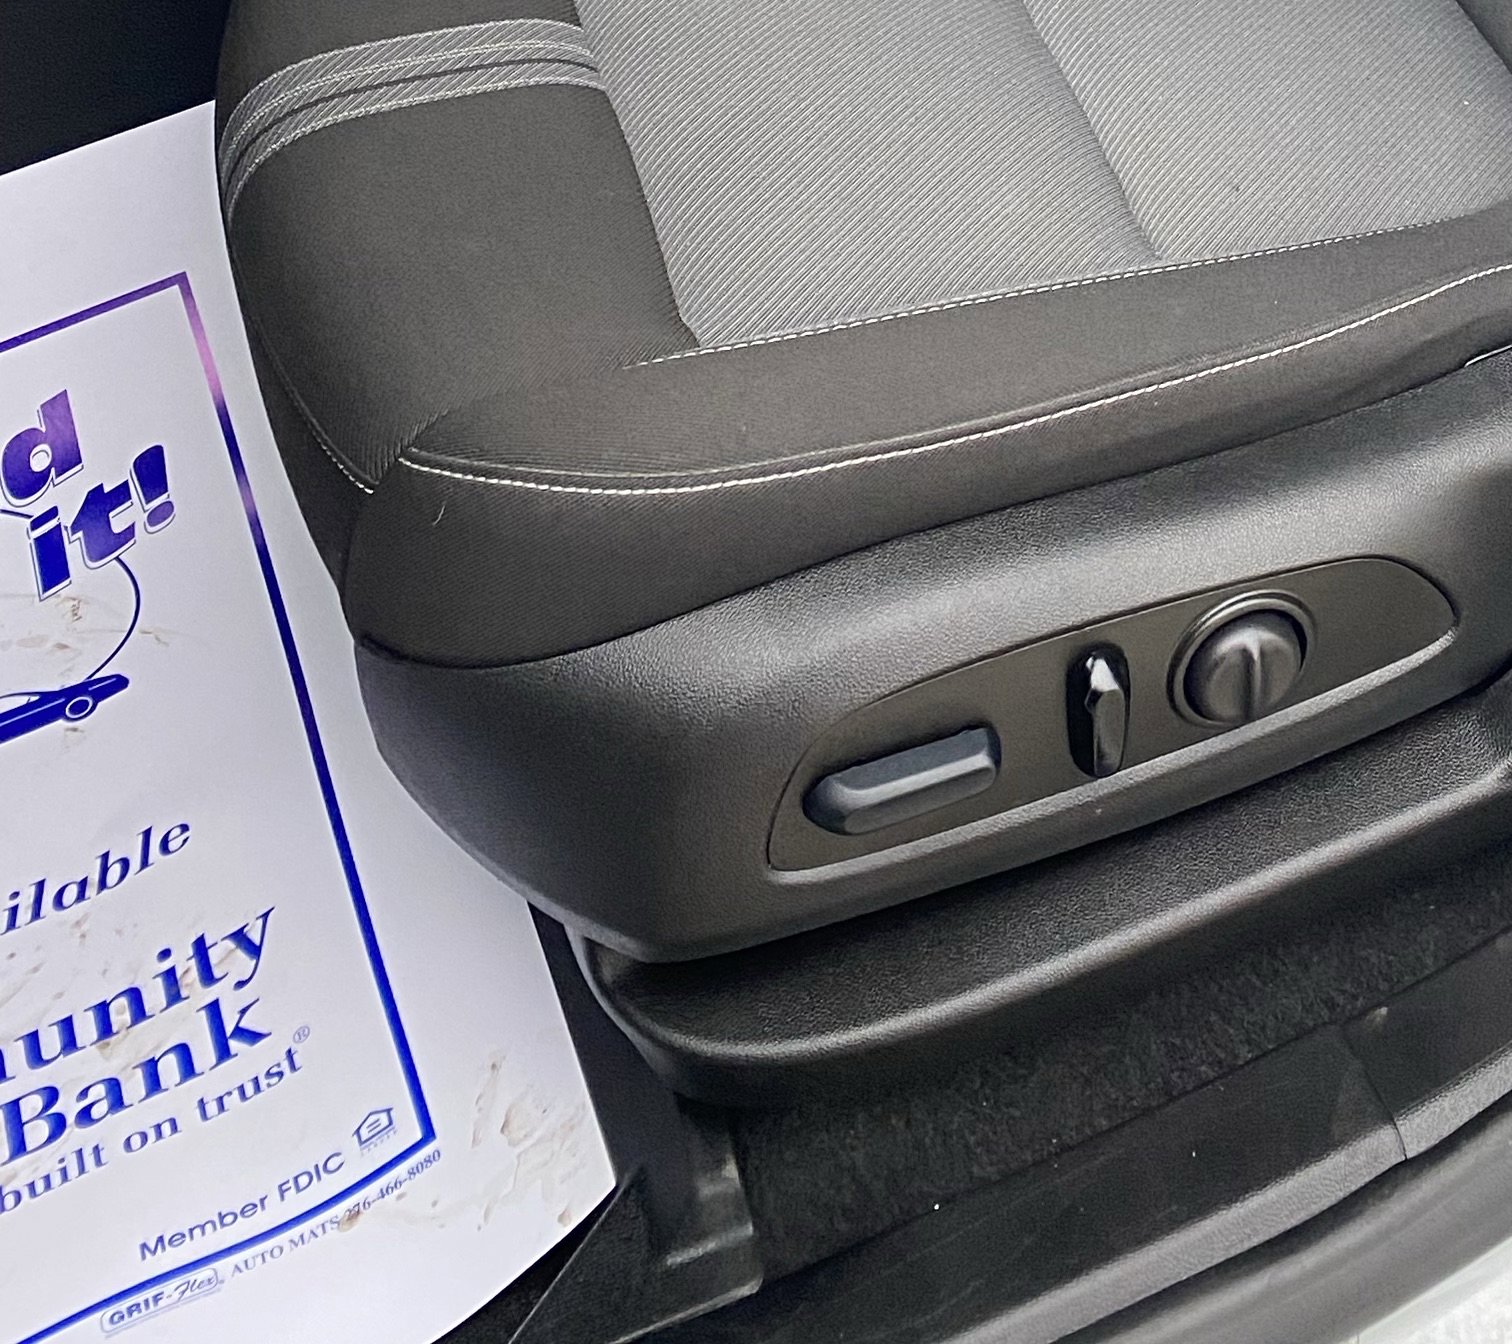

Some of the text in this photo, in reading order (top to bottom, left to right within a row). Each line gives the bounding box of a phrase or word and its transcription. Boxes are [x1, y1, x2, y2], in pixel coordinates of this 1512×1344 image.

[26, 444, 176, 602] it!
[0, 997, 272, 1164] Bank
[0, 1143, 109, 1213] built
[122, 1116, 182, 1153] on
[139, 1151, 345, 1262] Member FDIC
[231, 1245, 284, 1279] AUTO
[288, 1216, 340, 1254] MATS
[345, 1148, 442, 1221] 276-466-8080
